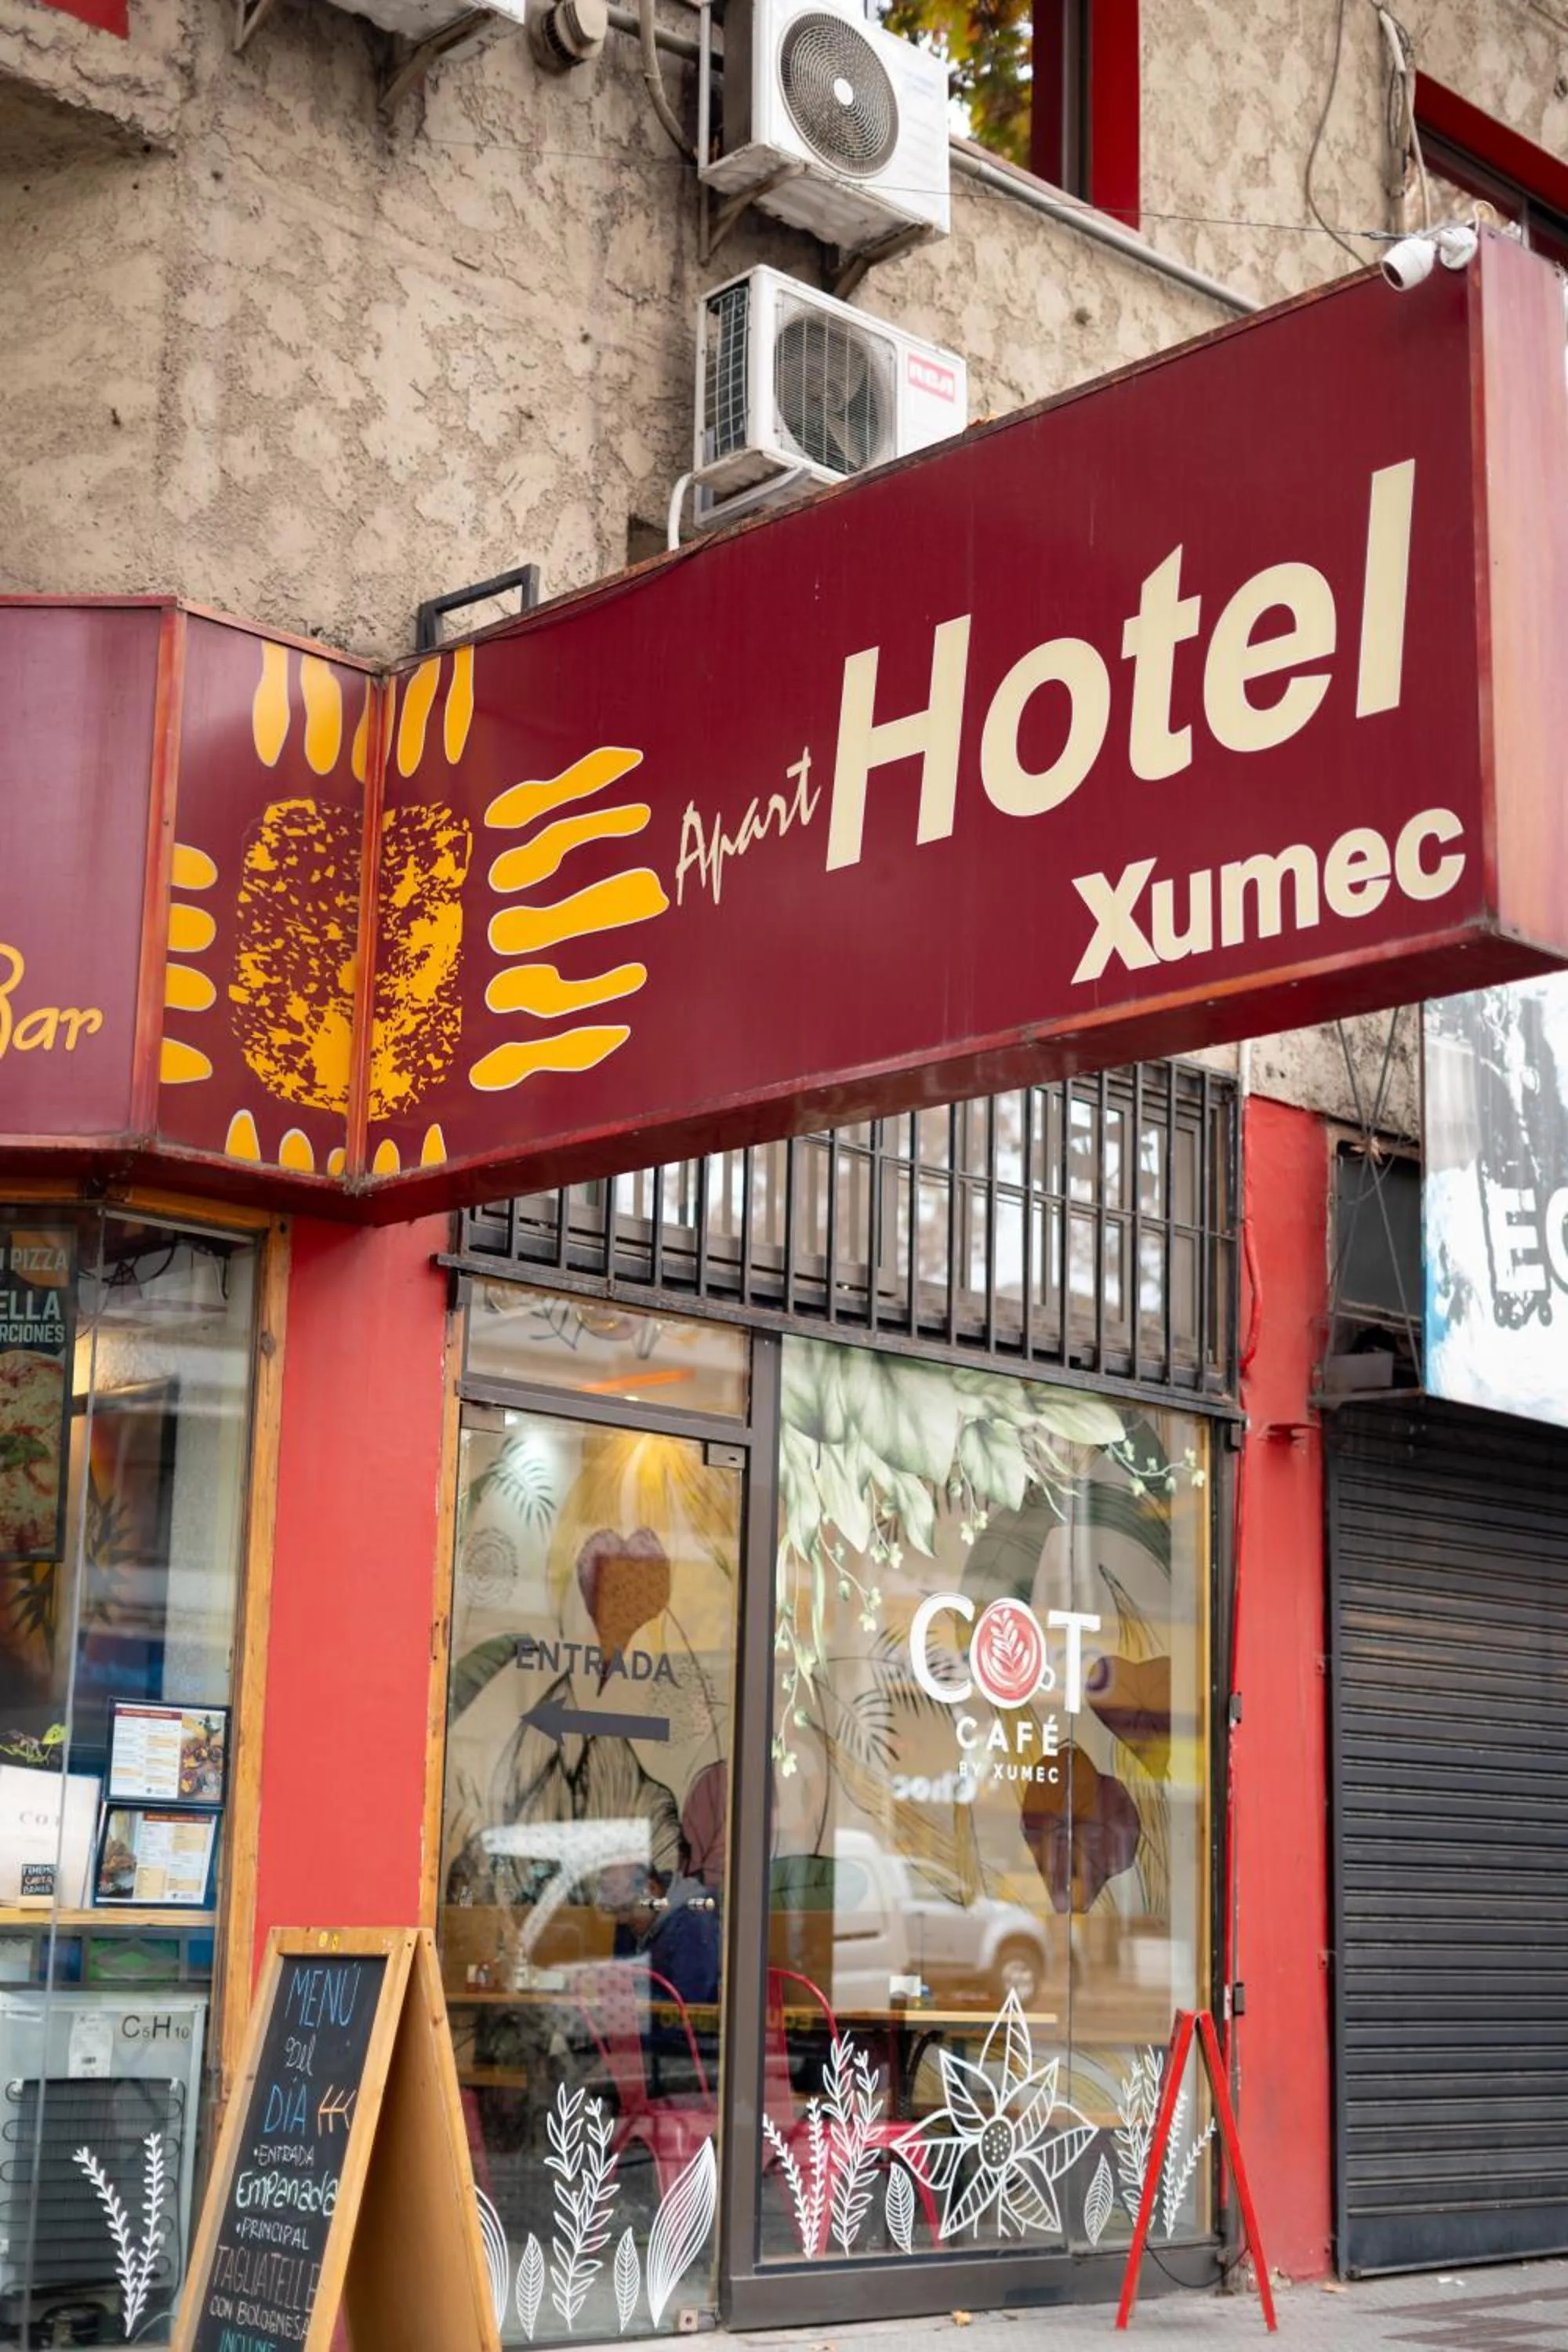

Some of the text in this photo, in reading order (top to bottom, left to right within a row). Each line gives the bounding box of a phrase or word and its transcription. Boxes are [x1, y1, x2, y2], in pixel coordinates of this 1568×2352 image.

[675, 458, 1415, 906] Apart Hotel
[10, 1247, 68, 1271] PIZZA
[515, 1640, 676, 1685] ENTRADA
[909, 1592, 1101, 1713] COT
[956, 1715, 1059, 1756] CAFÉ
[959, 1762, 1059, 1784] BY XUMEC
[285, 1962, 361, 2028] MENÚ
[263, 2077, 308, 2138] DÍA
[241, 2216, 310, 2250] PRINCIPAL
[212, 2245, 321, 2312] TAGLIATELLE
[209, 2294, 233, 2321] CON
